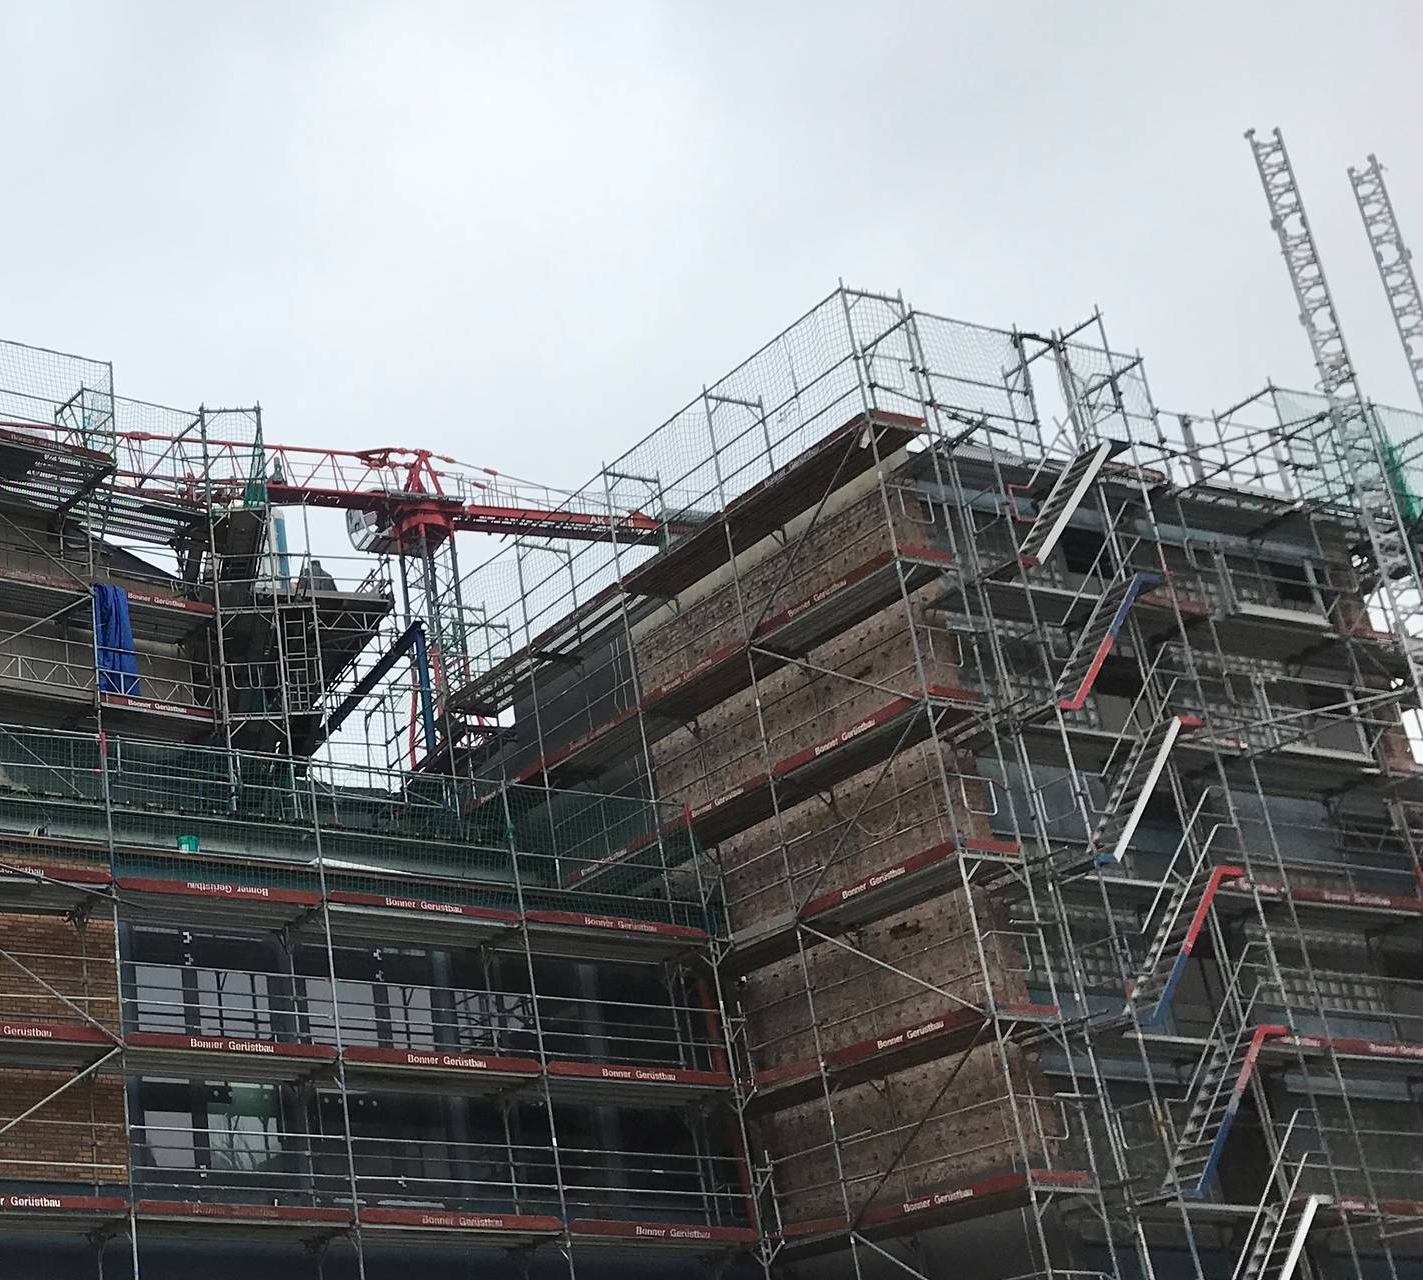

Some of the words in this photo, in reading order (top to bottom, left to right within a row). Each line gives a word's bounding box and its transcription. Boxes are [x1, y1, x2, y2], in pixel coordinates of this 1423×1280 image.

[128, 592, 150, 603] Bonner
[128, 699, 151, 709] Bonner
[815, 738, 838, 755] Bonner
[692, 801, 713, 818] Bonner
[237, 886, 269, 896] Bonner
[842, 882, 866, 899] Bonner
[385, 898, 417, 908] Bonner
[584, 917, 614, 928] Bonner
[190, 1038, 223, 1049] Bonner
[228, 1042, 274, 1053] Gerüstbau
[877, 1033, 904, 1049] Bonner
[407, 1055, 439, 1065] Bonner
[443, 1056, 486, 1069] Gerüstbau
[602, 1068, 632, 1078] Bonner
[635, 1069, 676, 1082] Gerüstbau
[9, 1196, 60, 1208] Gerüstbau
[904, 1197, 931, 1212] Bonner
[422, 1215, 454, 1226] Bonner
[635, 1226, 666, 1236] Bonner
